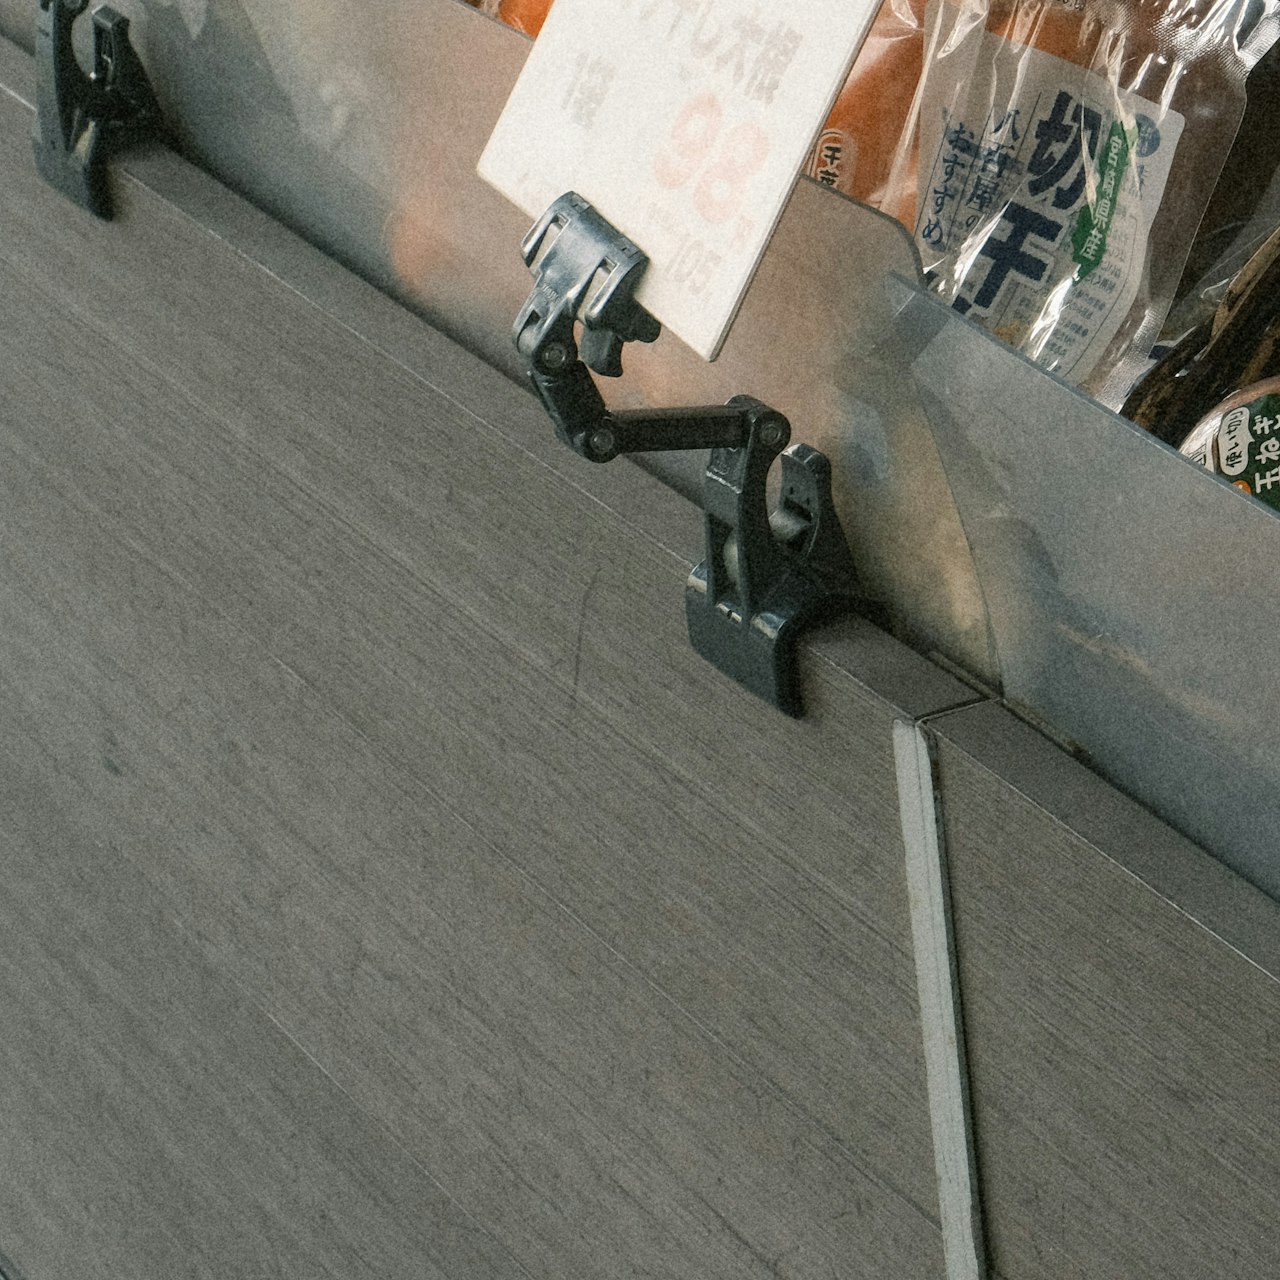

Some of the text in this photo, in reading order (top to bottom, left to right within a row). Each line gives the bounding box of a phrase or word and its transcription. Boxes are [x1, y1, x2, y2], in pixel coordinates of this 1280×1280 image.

[653, 91, 771, 226] 98
[921, 122, 976, 247] おすすめ
[1223, 410, 1244, 468] 使い切り
